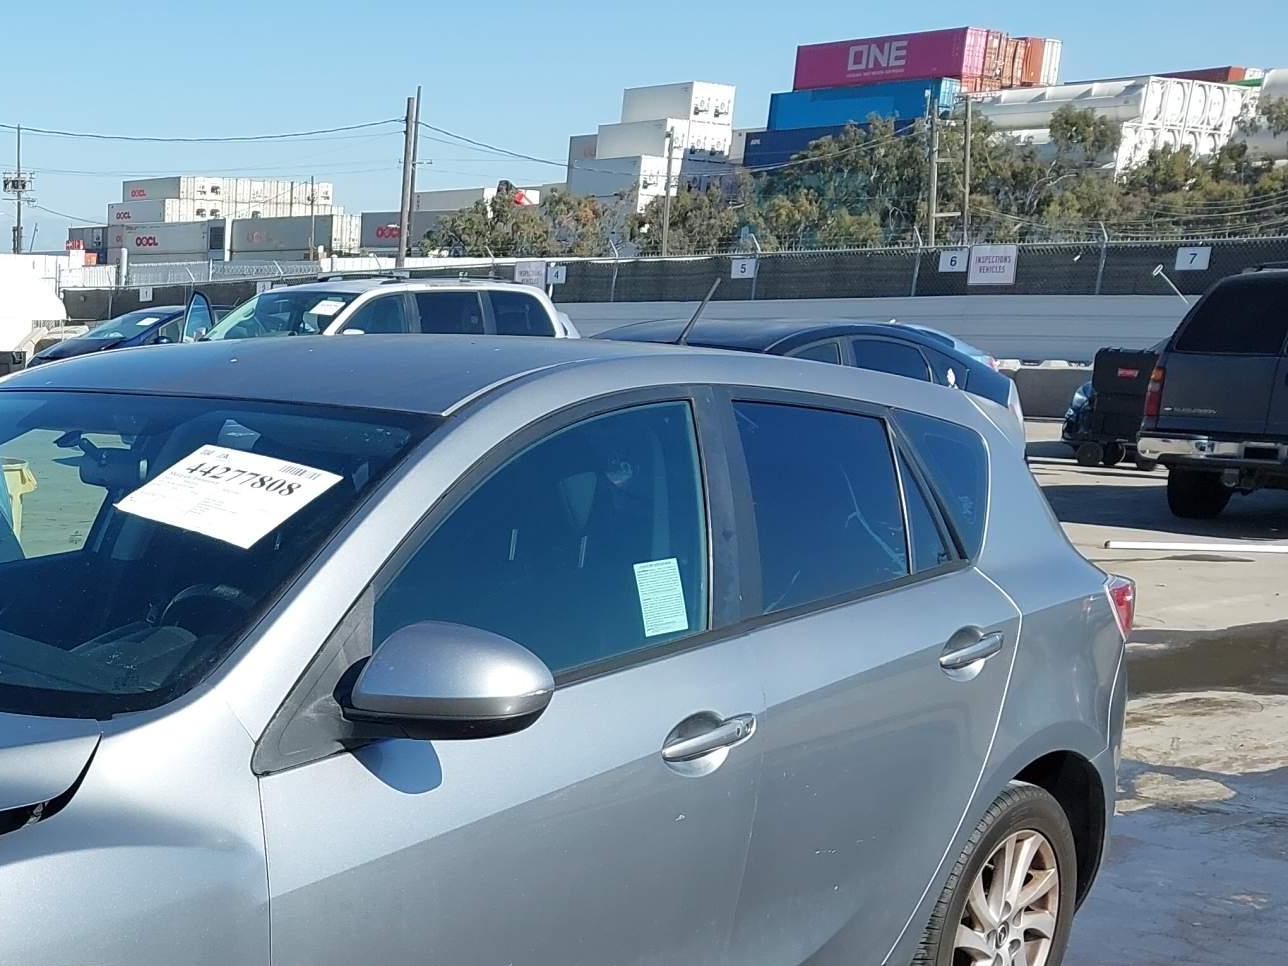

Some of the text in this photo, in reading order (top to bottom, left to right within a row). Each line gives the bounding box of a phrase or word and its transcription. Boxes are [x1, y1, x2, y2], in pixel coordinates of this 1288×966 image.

[847, 41, 908, 71] ONE
[115, 211, 132, 220] OOCL
[375, 224, 401, 240] OOC
[135, 236, 159, 247] OOCL
[949, 255, 958, 267] 6
[975, 255, 1012, 264] INSPECTIONS
[1189, 252, 1198, 265] 7
[740, 263, 747, 274] 5
[978, 265, 1006, 274] VEHICLES
[553, 270, 559, 280] 4
[186, 462, 302, 496] 44277808
